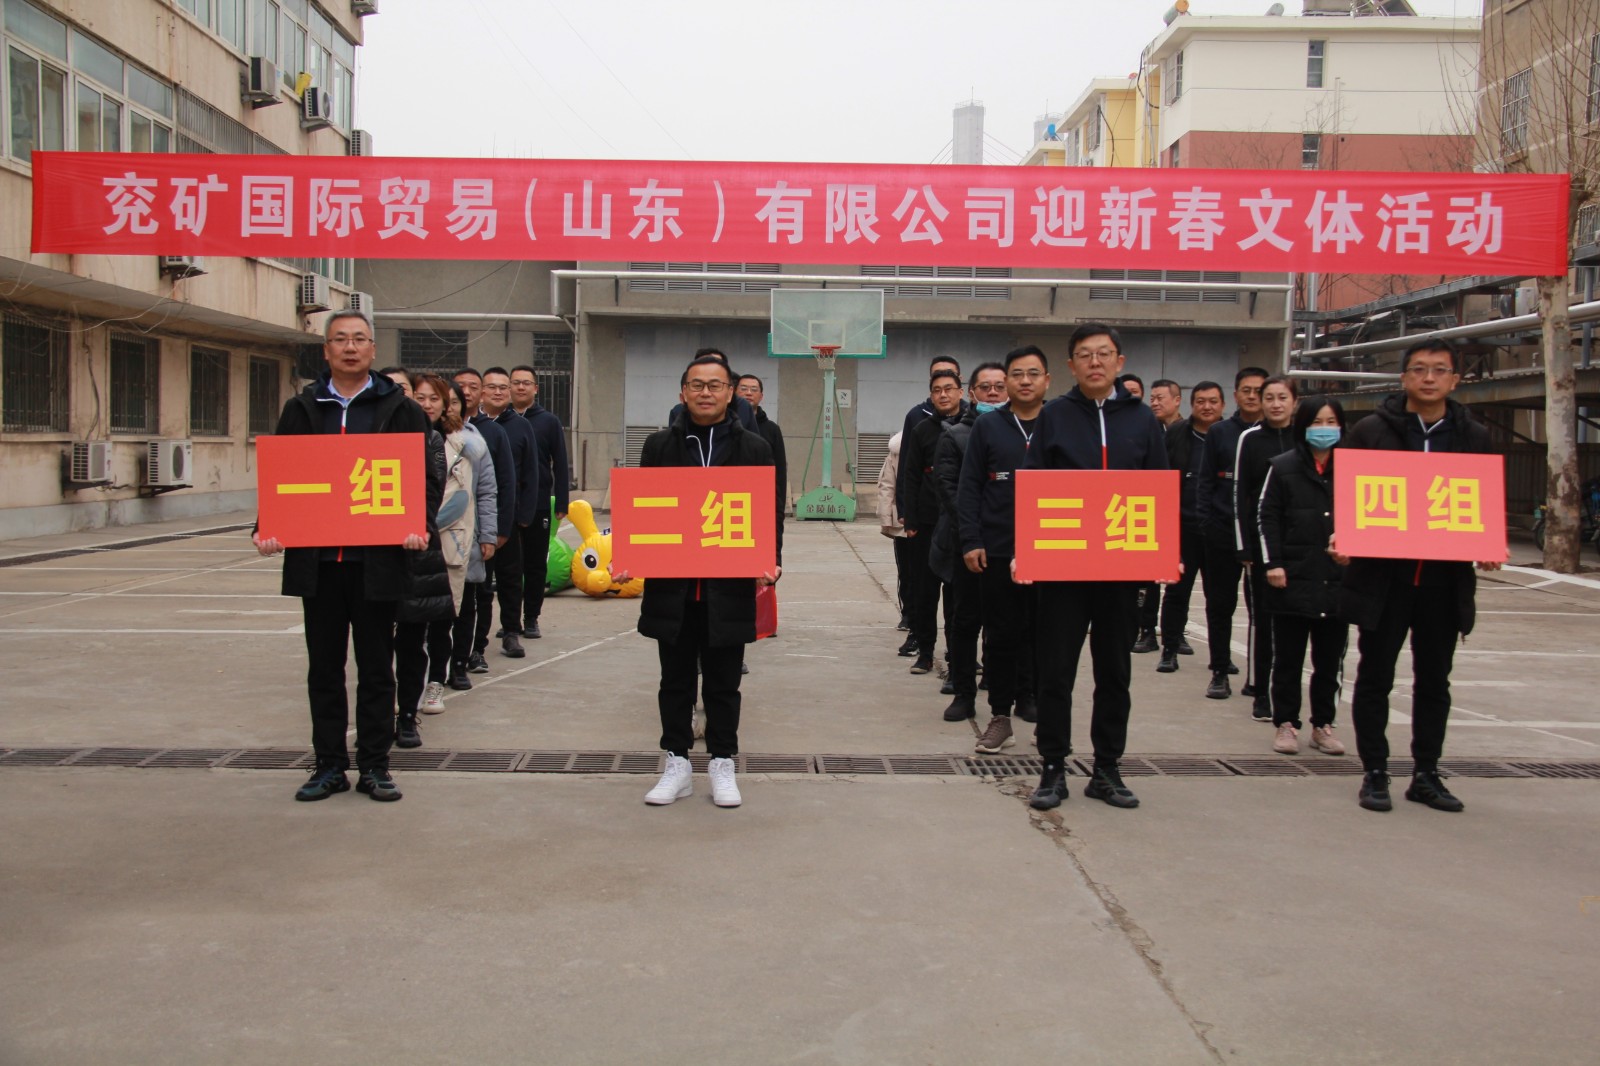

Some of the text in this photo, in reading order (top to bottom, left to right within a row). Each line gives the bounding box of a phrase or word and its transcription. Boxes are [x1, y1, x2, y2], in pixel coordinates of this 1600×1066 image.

[277, 457, 406, 515] 一组
[1354, 474, 1485, 533] 四组
[629, 490, 755, 548] 二组
[1034, 493, 1159, 551] 三组
